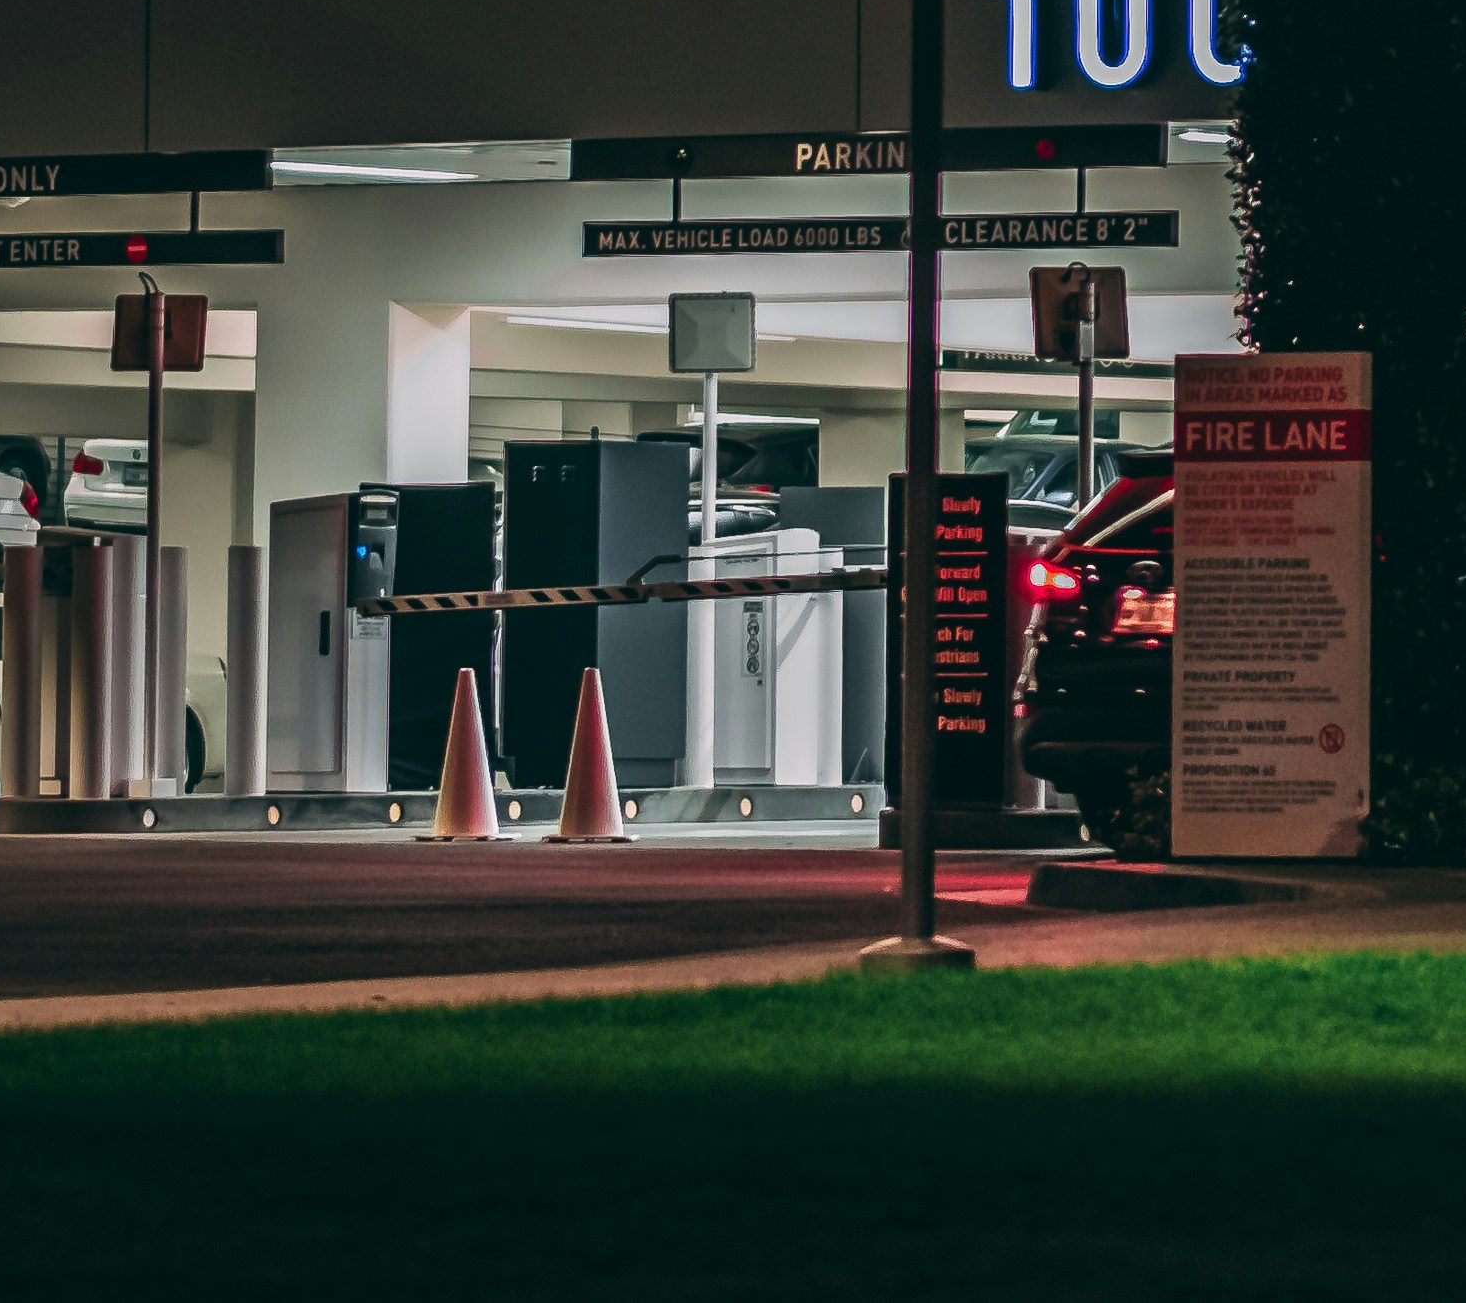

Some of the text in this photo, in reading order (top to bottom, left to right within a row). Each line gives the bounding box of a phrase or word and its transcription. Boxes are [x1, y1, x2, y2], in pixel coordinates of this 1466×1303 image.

[796, 141, 905, 171] PARKIN
[599, 231, 646, 250] MAX.
[651, 228, 732, 249] VEHICLE
[738, 227, 788, 248] LOAD
[794, 226, 838, 246] 6000
[844, 226, 881, 246] LBS
[945, 219, 1088, 243] CLEARANCE
[1096, 219, 1116, 241] 8'
[10, 239, 80, 262] ENTER
[1248, 367, 1270, 382] NO
[1274, 366, 1343, 382] PARKING
[1204, 387, 1254, 402] AREAS
[1259, 386, 1323, 402] MARKED
[1328, 386, 1347, 401] AS
[1186, 420, 1347, 451] FIRE LANE
[935, 524, 983, 543] Parking
[936, 563, 981, 581] orward
[943, 687, 982, 707] Slowly
[937, 715, 986, 734] Parking
